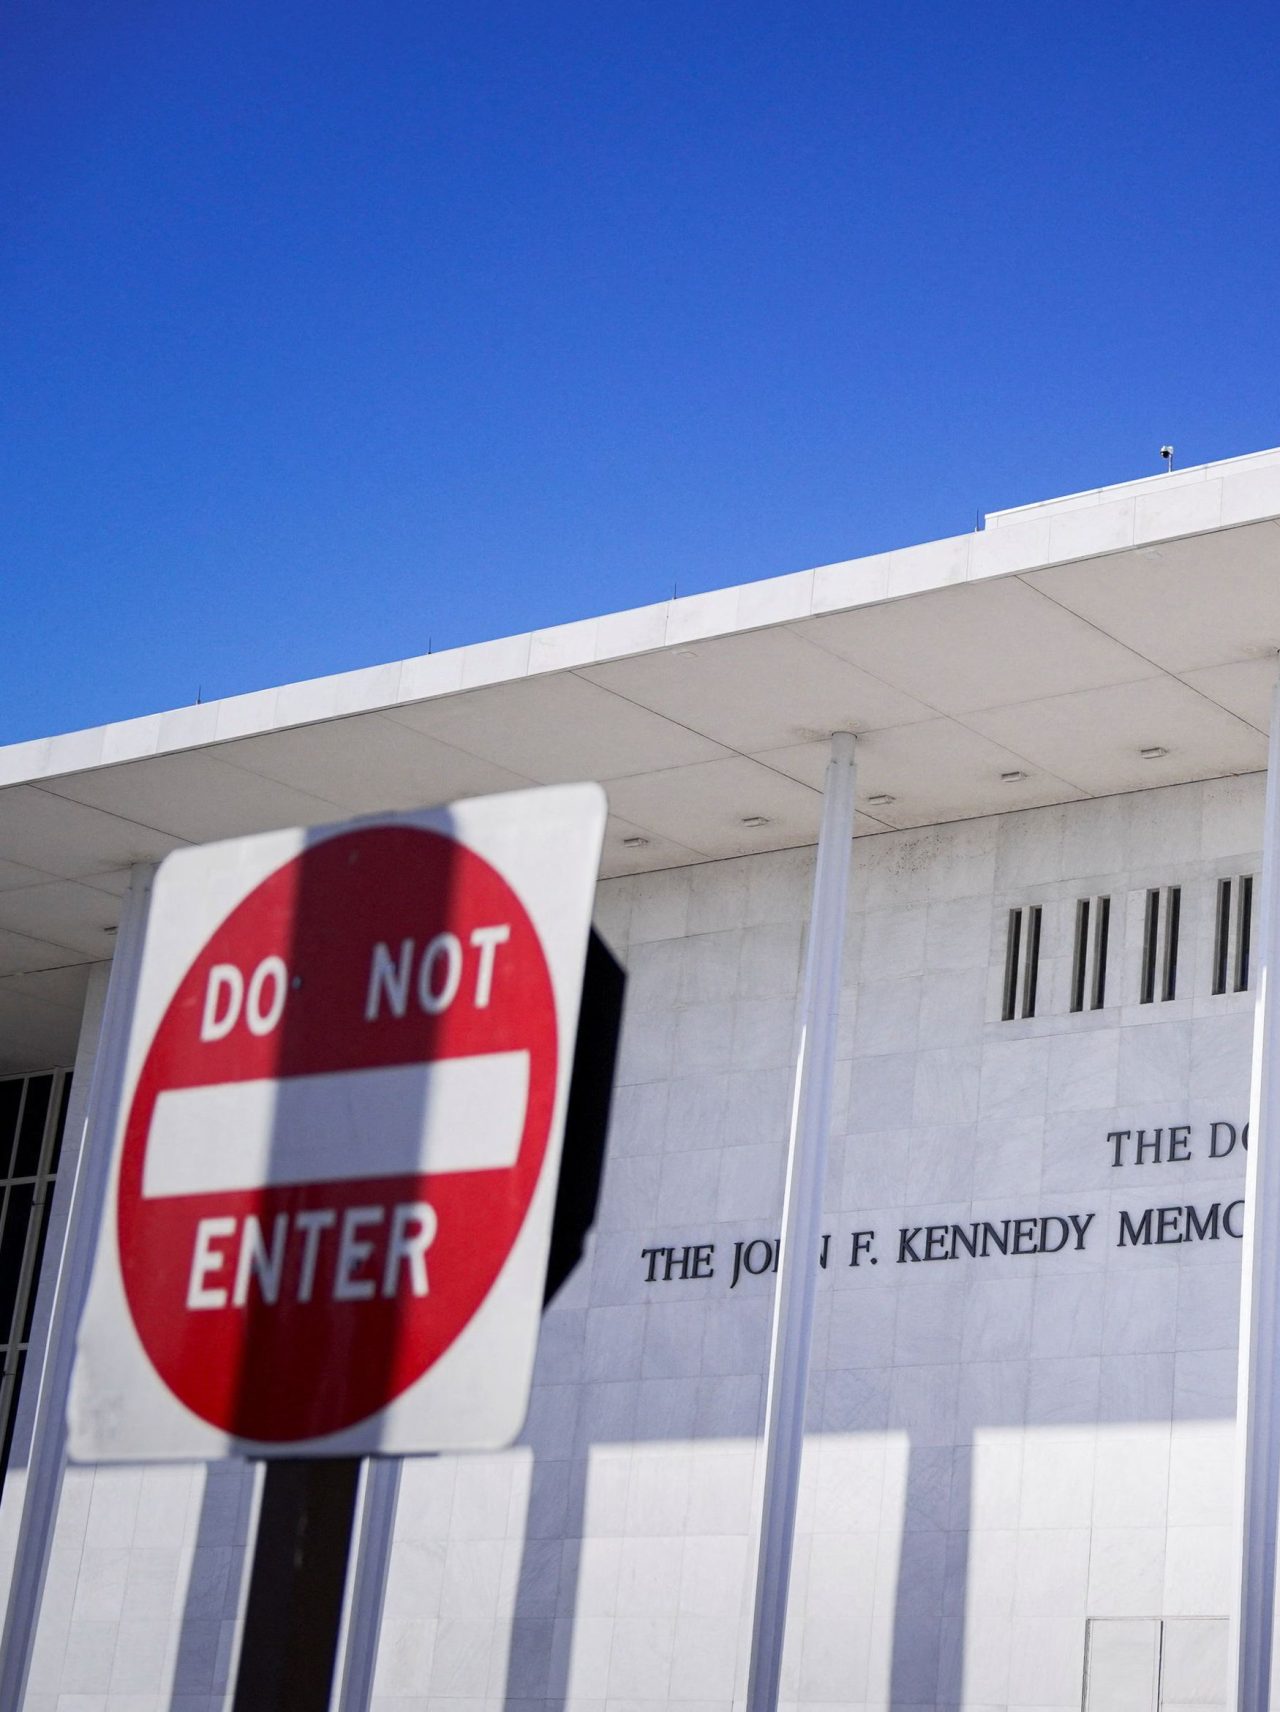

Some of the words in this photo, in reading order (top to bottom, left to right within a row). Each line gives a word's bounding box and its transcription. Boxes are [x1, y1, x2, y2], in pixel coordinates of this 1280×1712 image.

[201, 957, 287, 1042] DO
[365, 924, 510, 1022] NOT
[1106, 1125, 1192, 1168] THE
[187, 1201, 437, 1310] ENTER
[640, 1243, 715, 1283] THE
[848, 1230, 878, 1267] F.
[896, 1213, 1096, 1264] KENNEDY
